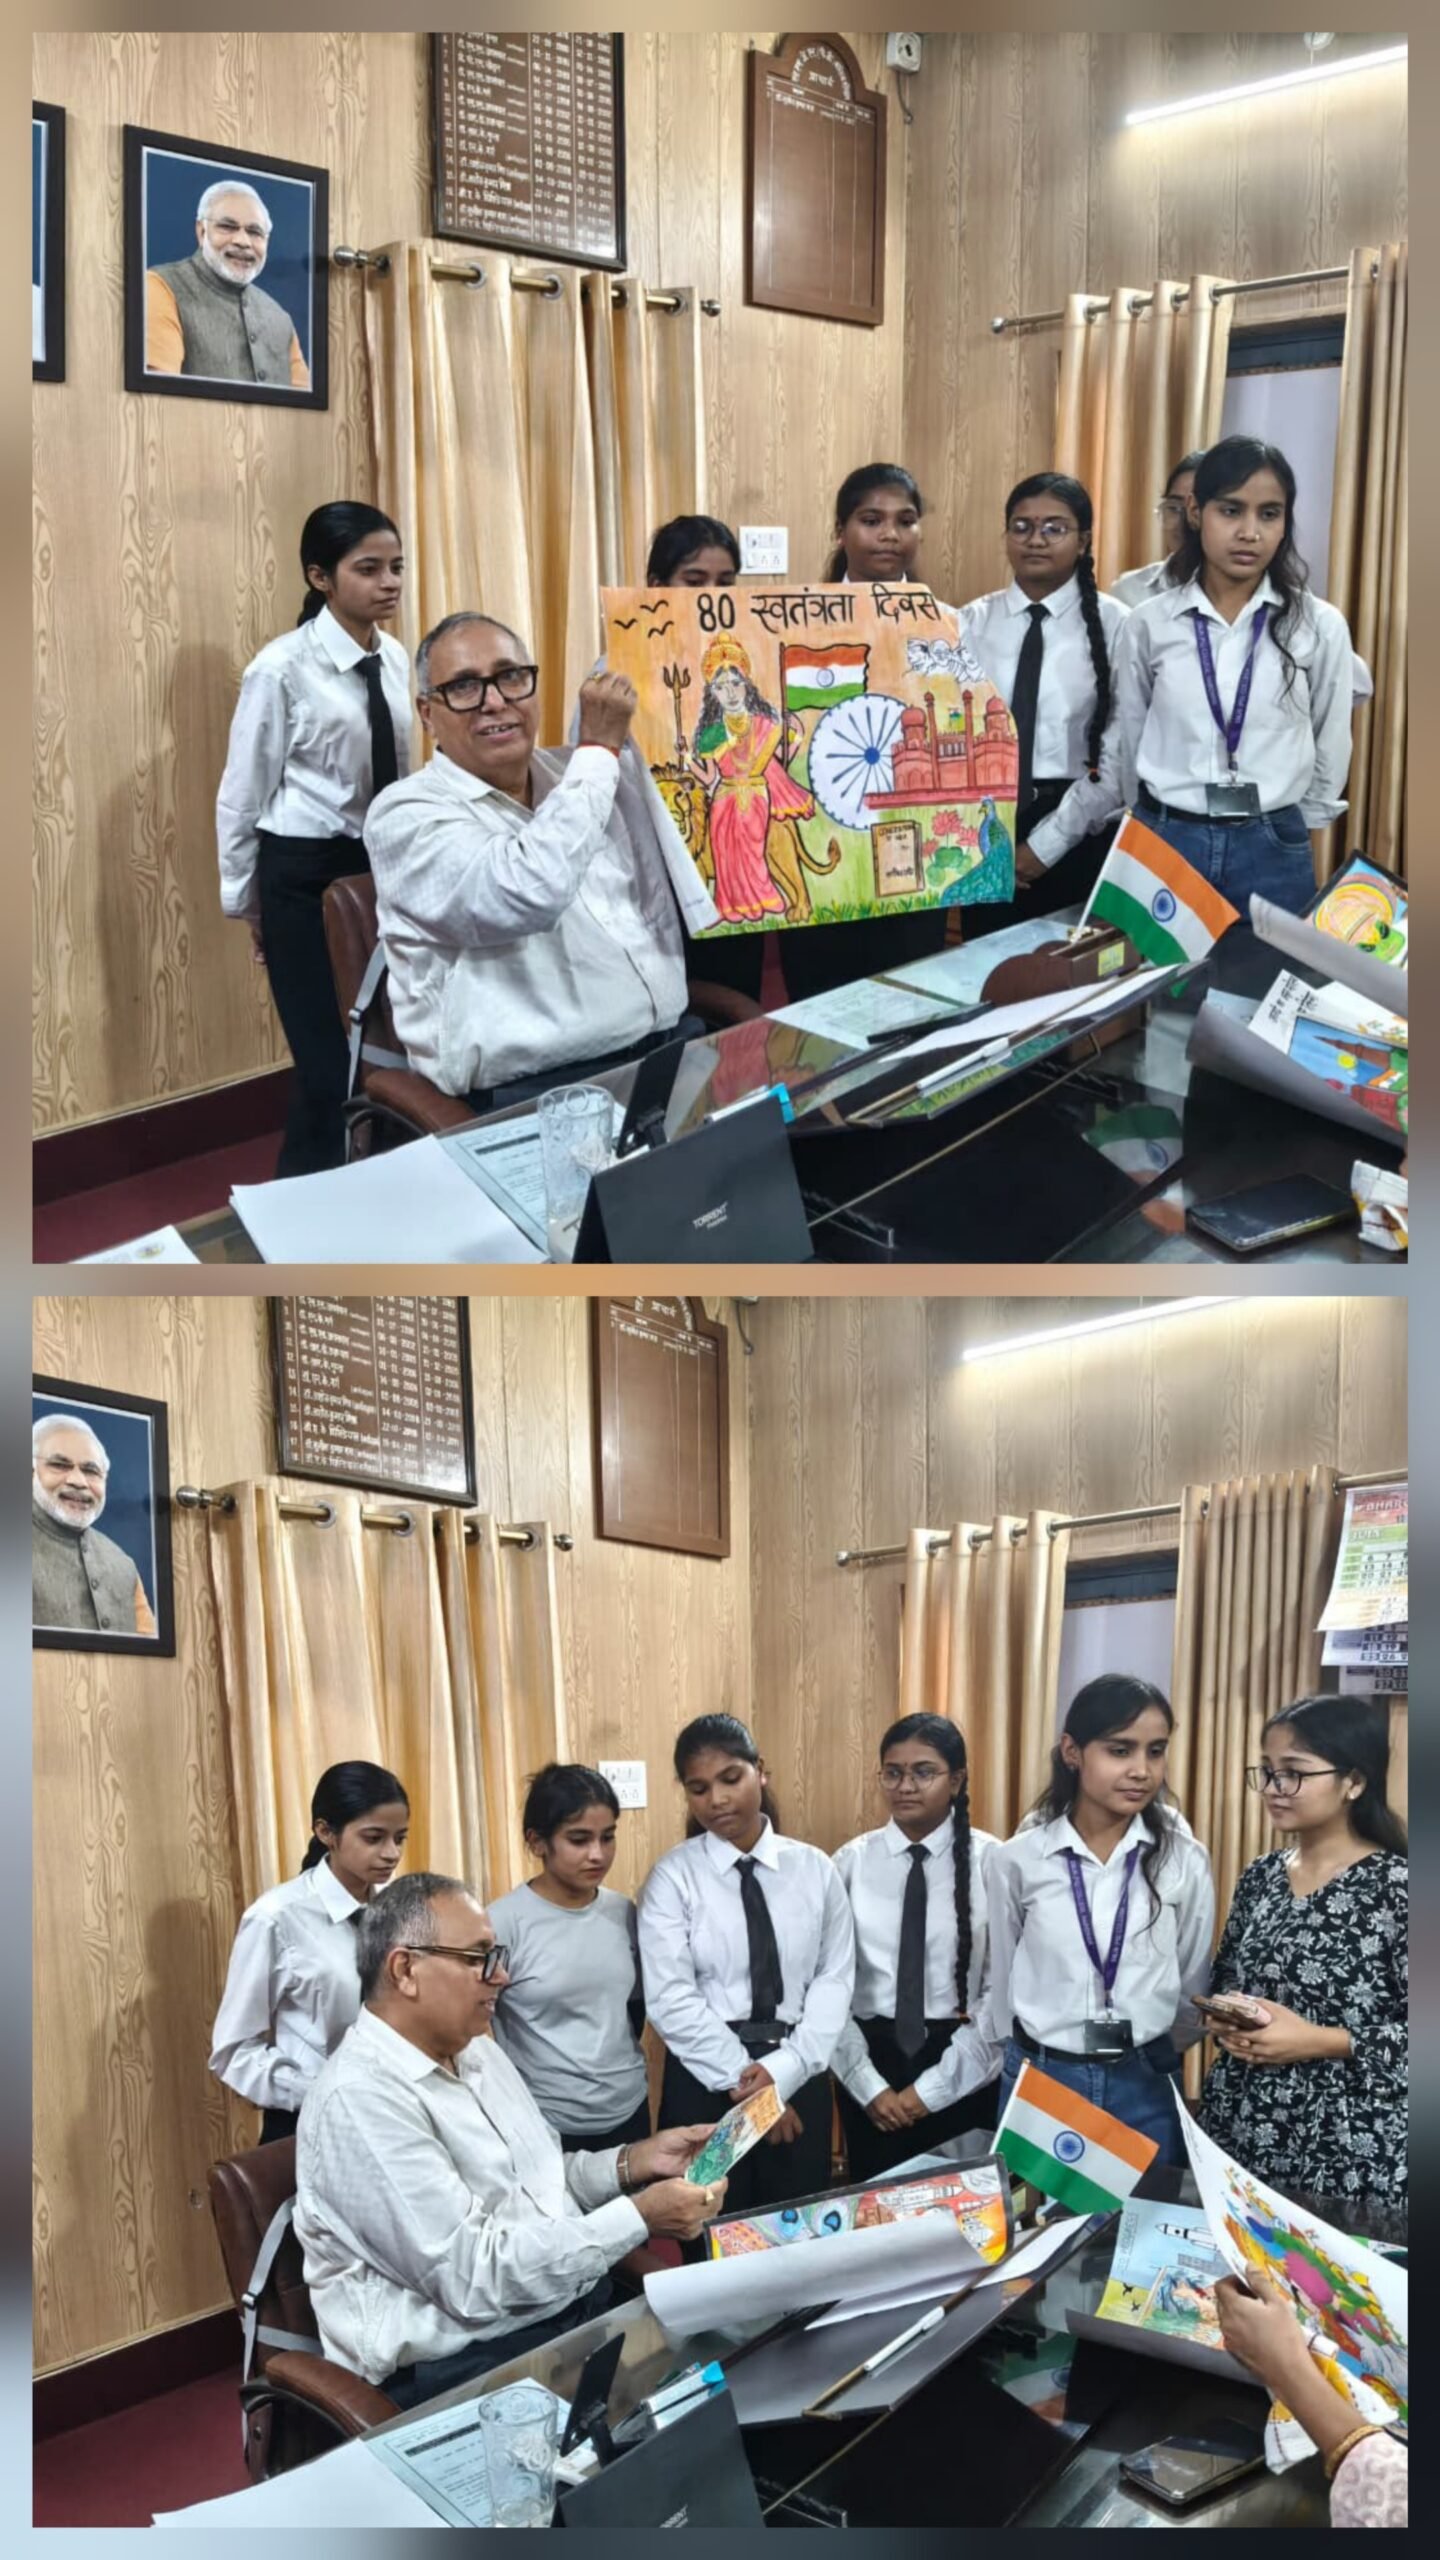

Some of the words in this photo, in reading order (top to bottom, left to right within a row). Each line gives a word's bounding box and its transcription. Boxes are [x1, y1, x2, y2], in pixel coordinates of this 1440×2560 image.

[697, 592, 736, 632] 80
[750, 587, 856, 634] स्वतंत्रता
[870, 583, 941, 624] दिवस
